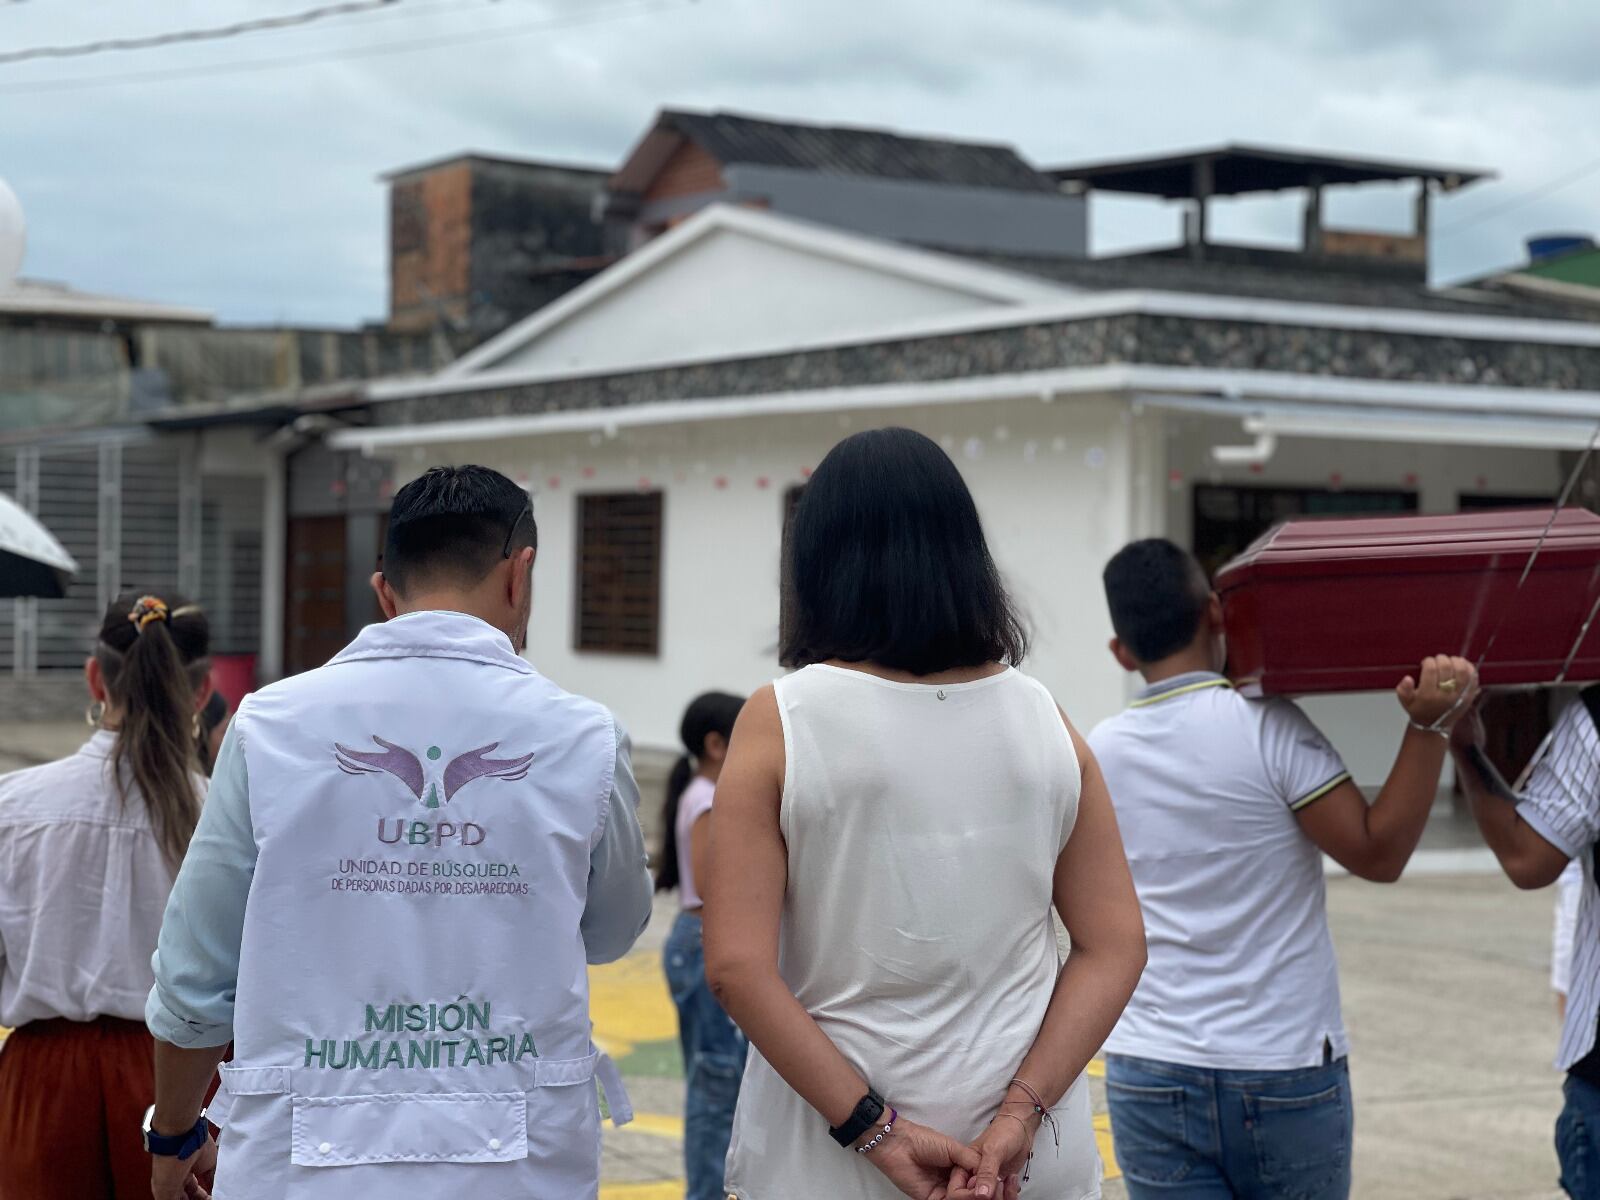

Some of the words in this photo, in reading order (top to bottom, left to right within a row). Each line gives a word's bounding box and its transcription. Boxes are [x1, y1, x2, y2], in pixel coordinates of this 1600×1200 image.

[377, 818, 486, 846] UBPD
[339, 859, 401, 875] UNIDAD
[407, 862, 429, 876] DE
[432, 860, 520, 878] BÚSQUEDA
[332, 879, 345, 890] DE
[346, 879, 395, 892] PERSONAS
[398, 881, 432, 893] DADAS
[434, 882, 452, 894] POR
[455, 882, 529, 895] DESAPARECIDAS
[364, 994, 491, 1032] MISIÓN
[303, 1032, 539, 1069] HUMANITARIA
